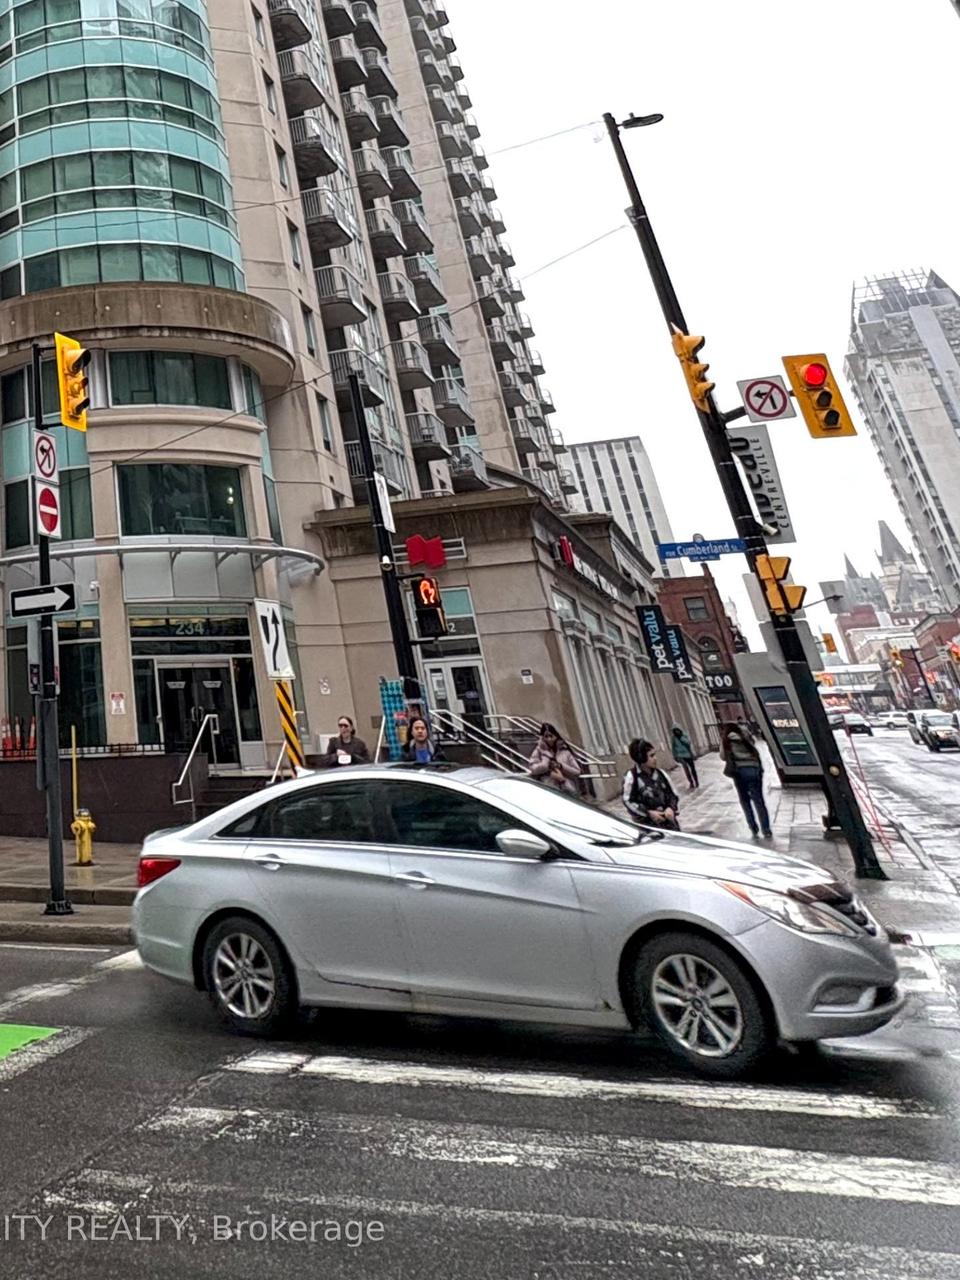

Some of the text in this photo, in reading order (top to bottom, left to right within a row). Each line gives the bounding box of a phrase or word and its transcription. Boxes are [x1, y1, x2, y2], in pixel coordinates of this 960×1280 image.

[676, 542, 730, 556] Cumberland
[175, 621, 205, 635] 234
[643, 609, 674, 669] pet valu
[676, 657, 692, 679] pet
